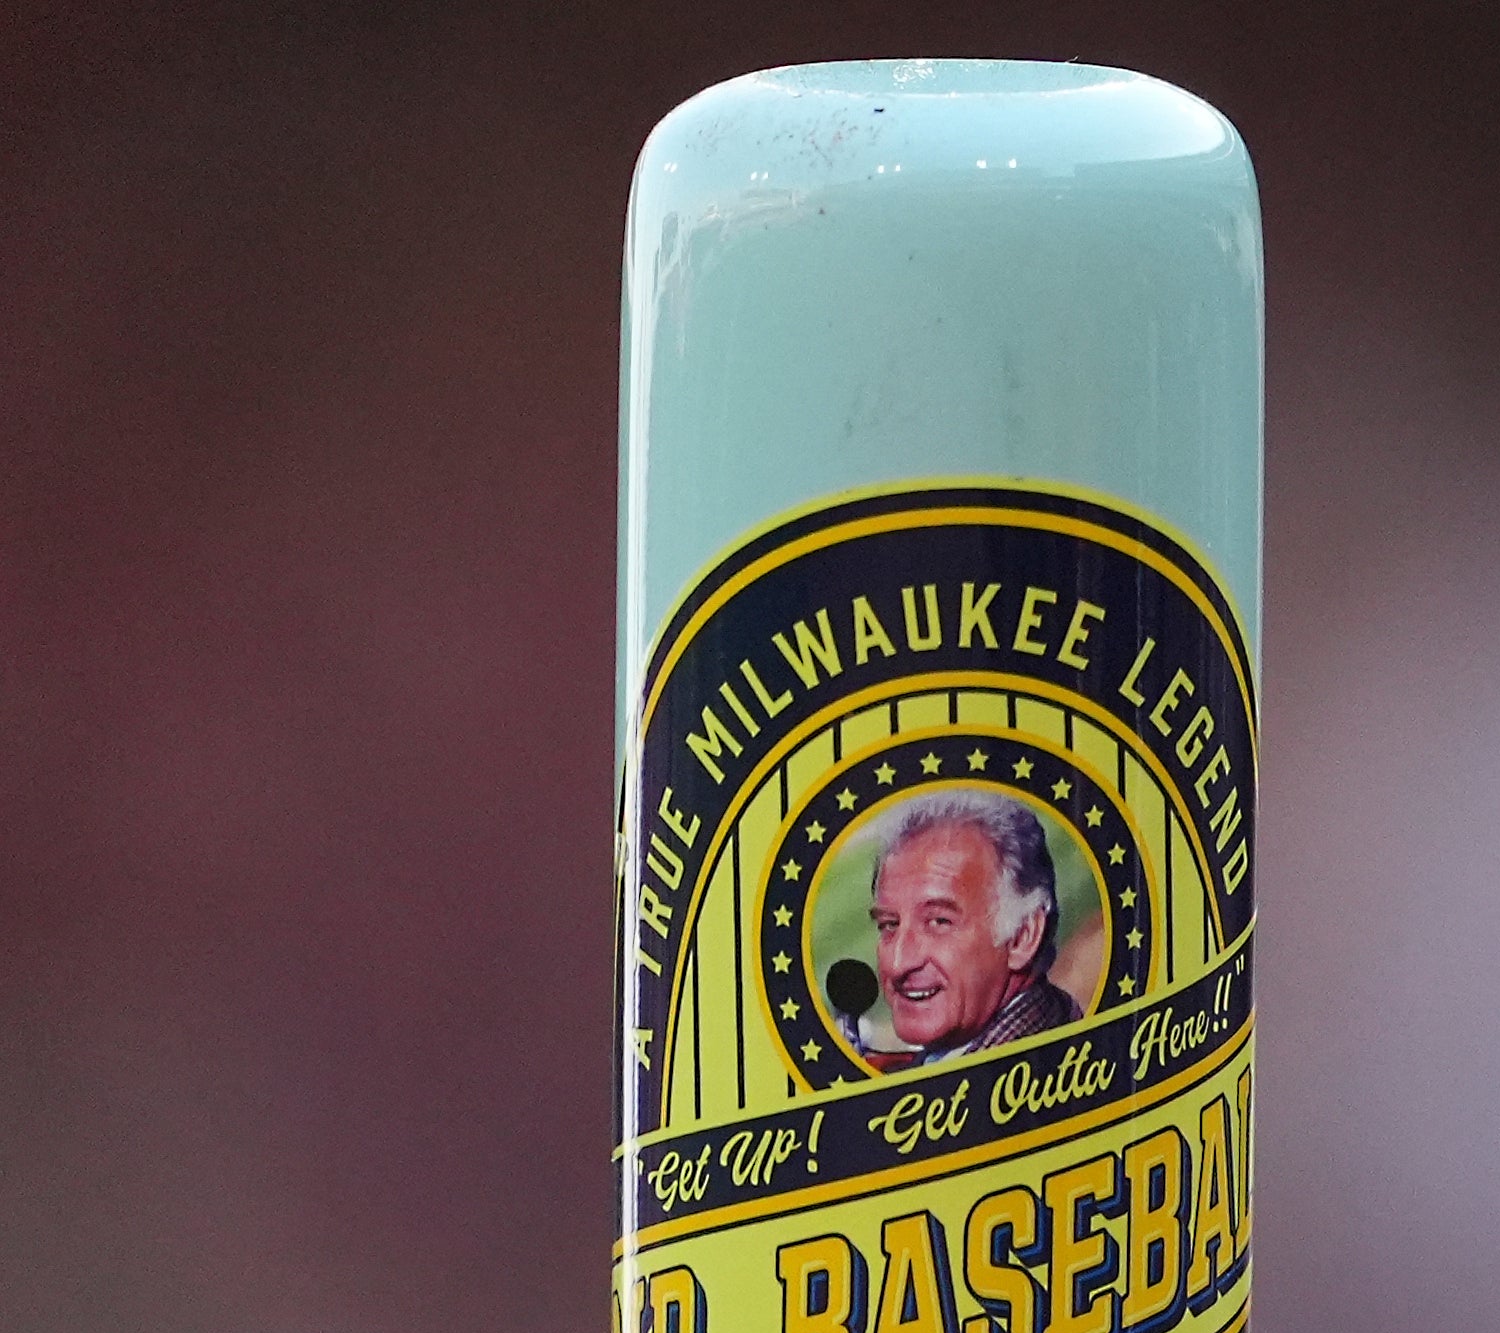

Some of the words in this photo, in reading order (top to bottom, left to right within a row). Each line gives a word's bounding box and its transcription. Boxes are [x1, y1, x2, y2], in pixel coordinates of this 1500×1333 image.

[633, 785, 702, 978] TRUE
[685, 581, 1106, 785] MILWAUKEE
[1117, 636, 1249, 897] LEGEND
[719, 1110, 825, 1188] Up!
[867, 1086, 970, 1155] Get
[989, 1045, 1115, 1124] Outta
